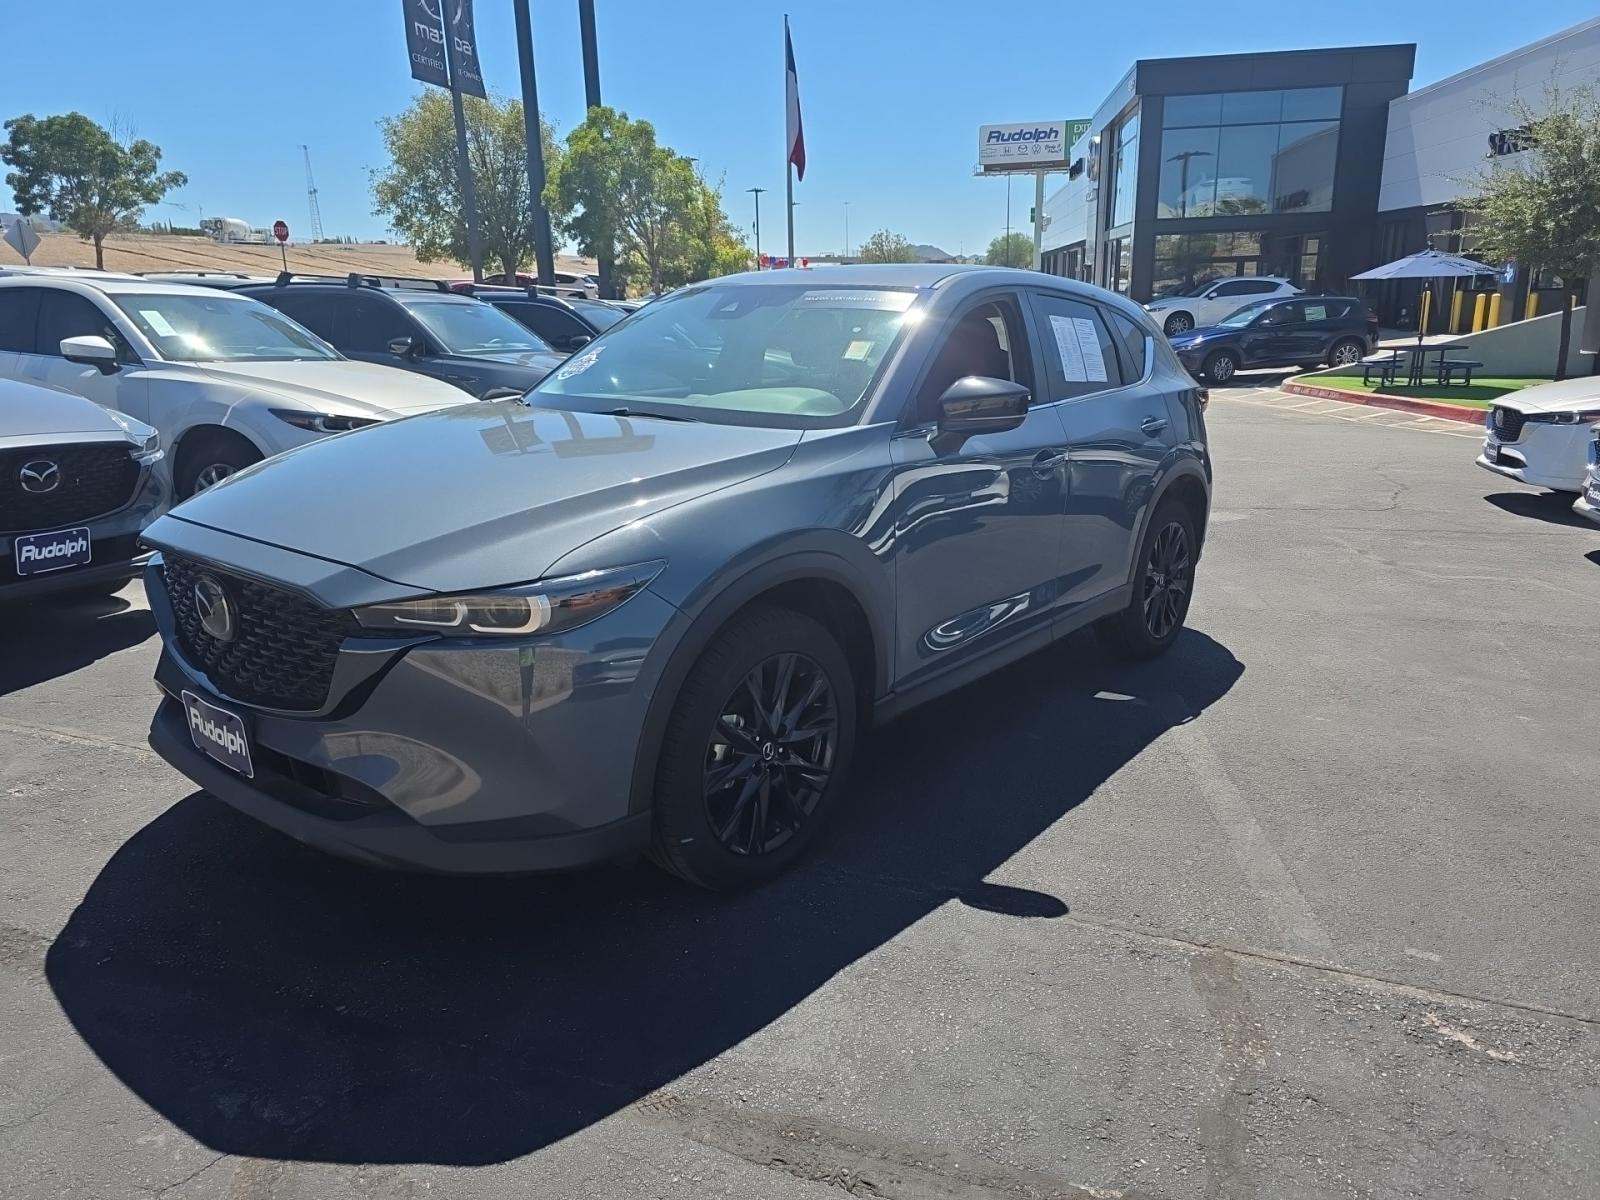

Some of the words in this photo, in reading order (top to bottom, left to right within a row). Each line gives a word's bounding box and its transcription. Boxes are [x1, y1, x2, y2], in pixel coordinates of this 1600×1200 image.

[986, 127, 1059, 142] Rudolph
[274, 227, 288, 235] STOP
[21, 537, 87, 562] Rudolph
[190, 706, 246, 756] Rudolph
